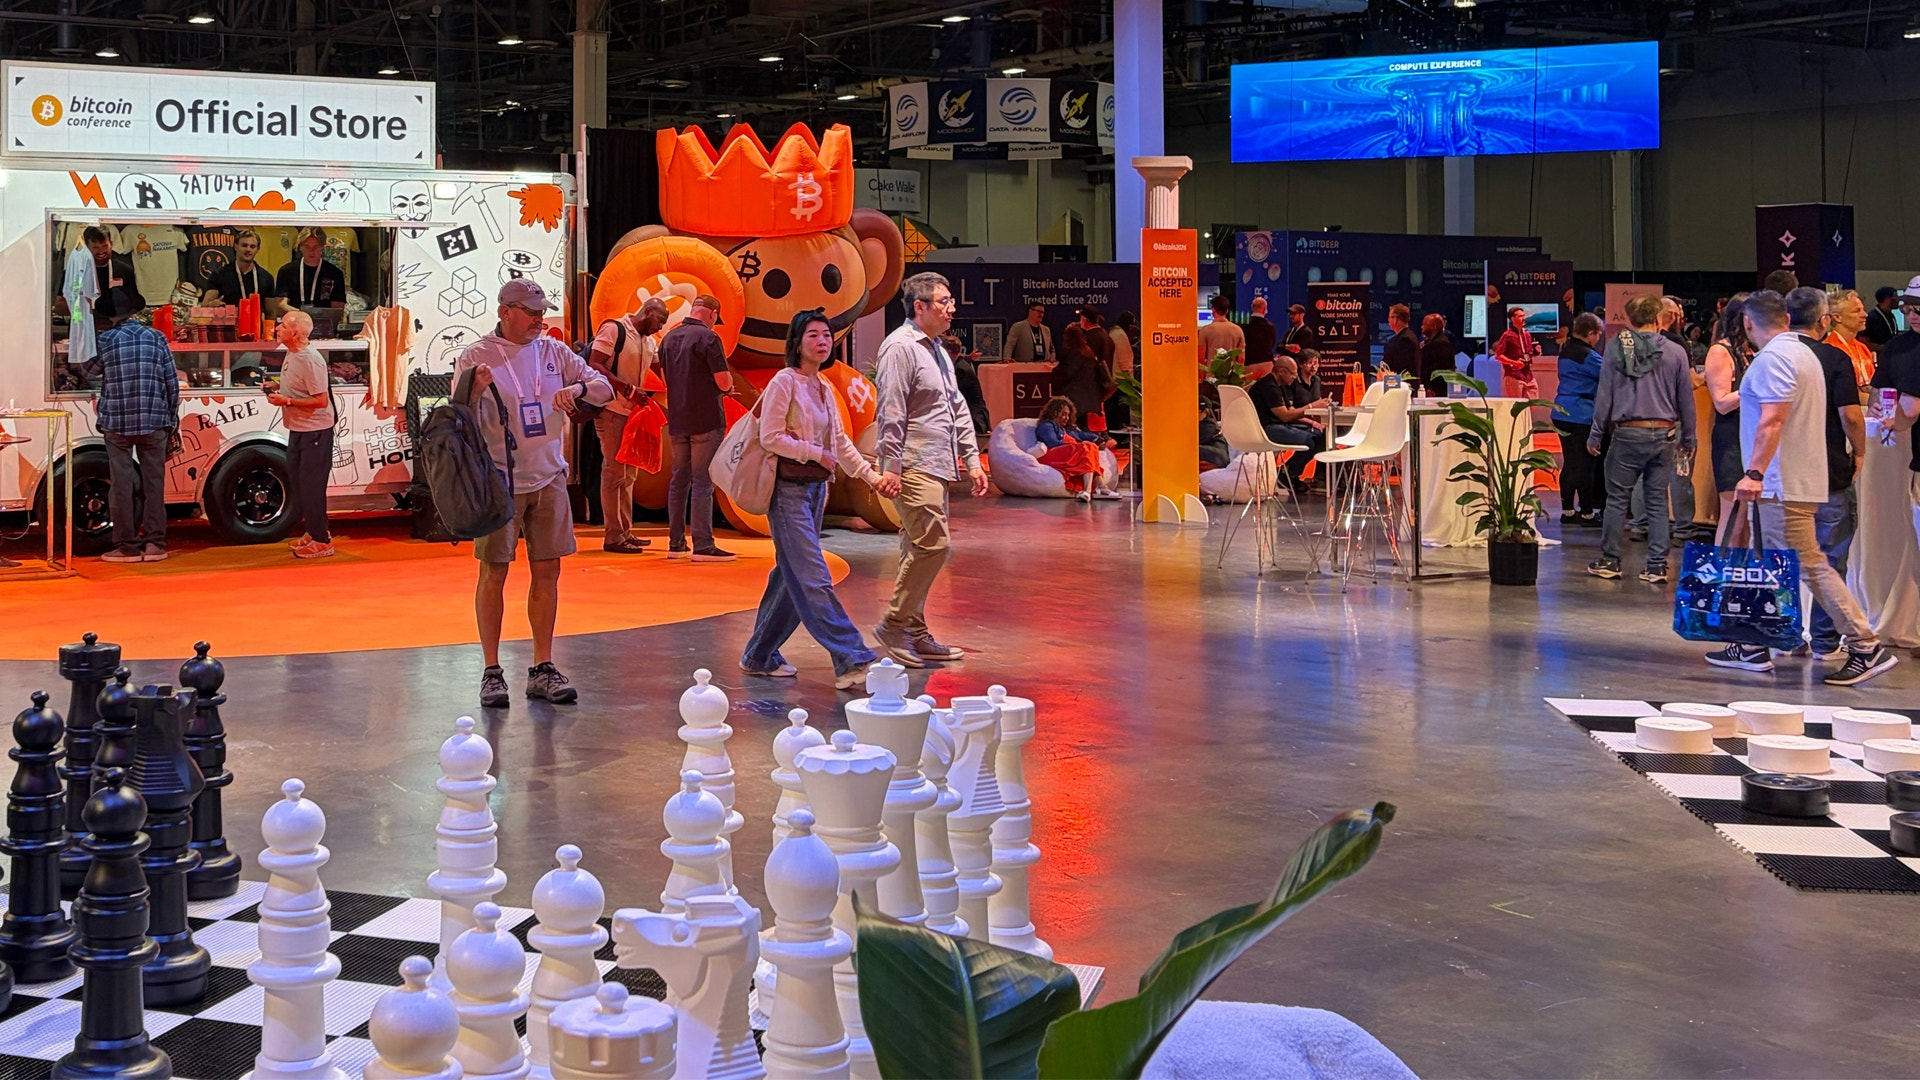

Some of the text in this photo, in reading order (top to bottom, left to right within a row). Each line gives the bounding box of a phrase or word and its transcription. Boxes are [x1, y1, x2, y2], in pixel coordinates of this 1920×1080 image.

[1388, 59, 1482, 71] COMPUTE EXPERIENCE
[69, 96, 133, 114] bitcoin
[67, 115, 131, 129] conference
[155, 99, 407, 140] Official Store
[936, 127, 975, 135] MOONSHOT
[1059, 128, 1091, 136] MOONSHOT
[179, 174, 255, 195] SATOSHI
[868, 178, 894, 192] Cake
[443, 229, 470, 256] 21
[1309, 239, 1339, 248] BITDEER
[1442, 260, 1469, 269] Bitcoin
[1152, 267, 1188, 277] BITCOIN
[1520, 272, 1556, 280] BITDEER
[1022, 278, 1119, 289] Bitcoin-Backed Loans
[1147, 278, 1193, 287] ACCEPTED
[1159, 288, 1182, 298] HERE
[1022, 294, 1109, 305] Trusted Since 2016
[1325, 299, 1362, 311] bitcoin
[1317, 325, 1360, 336] SALT
[1164, 334, 1189, 345] Square
[1016, 383, 1053, 399] SAL
[196, 399, 260, 432] RARE
[363, 420, 409, 442] HOD
[366, 434, 413, 456] HOD
[369, 448, 414, 470] HOD
